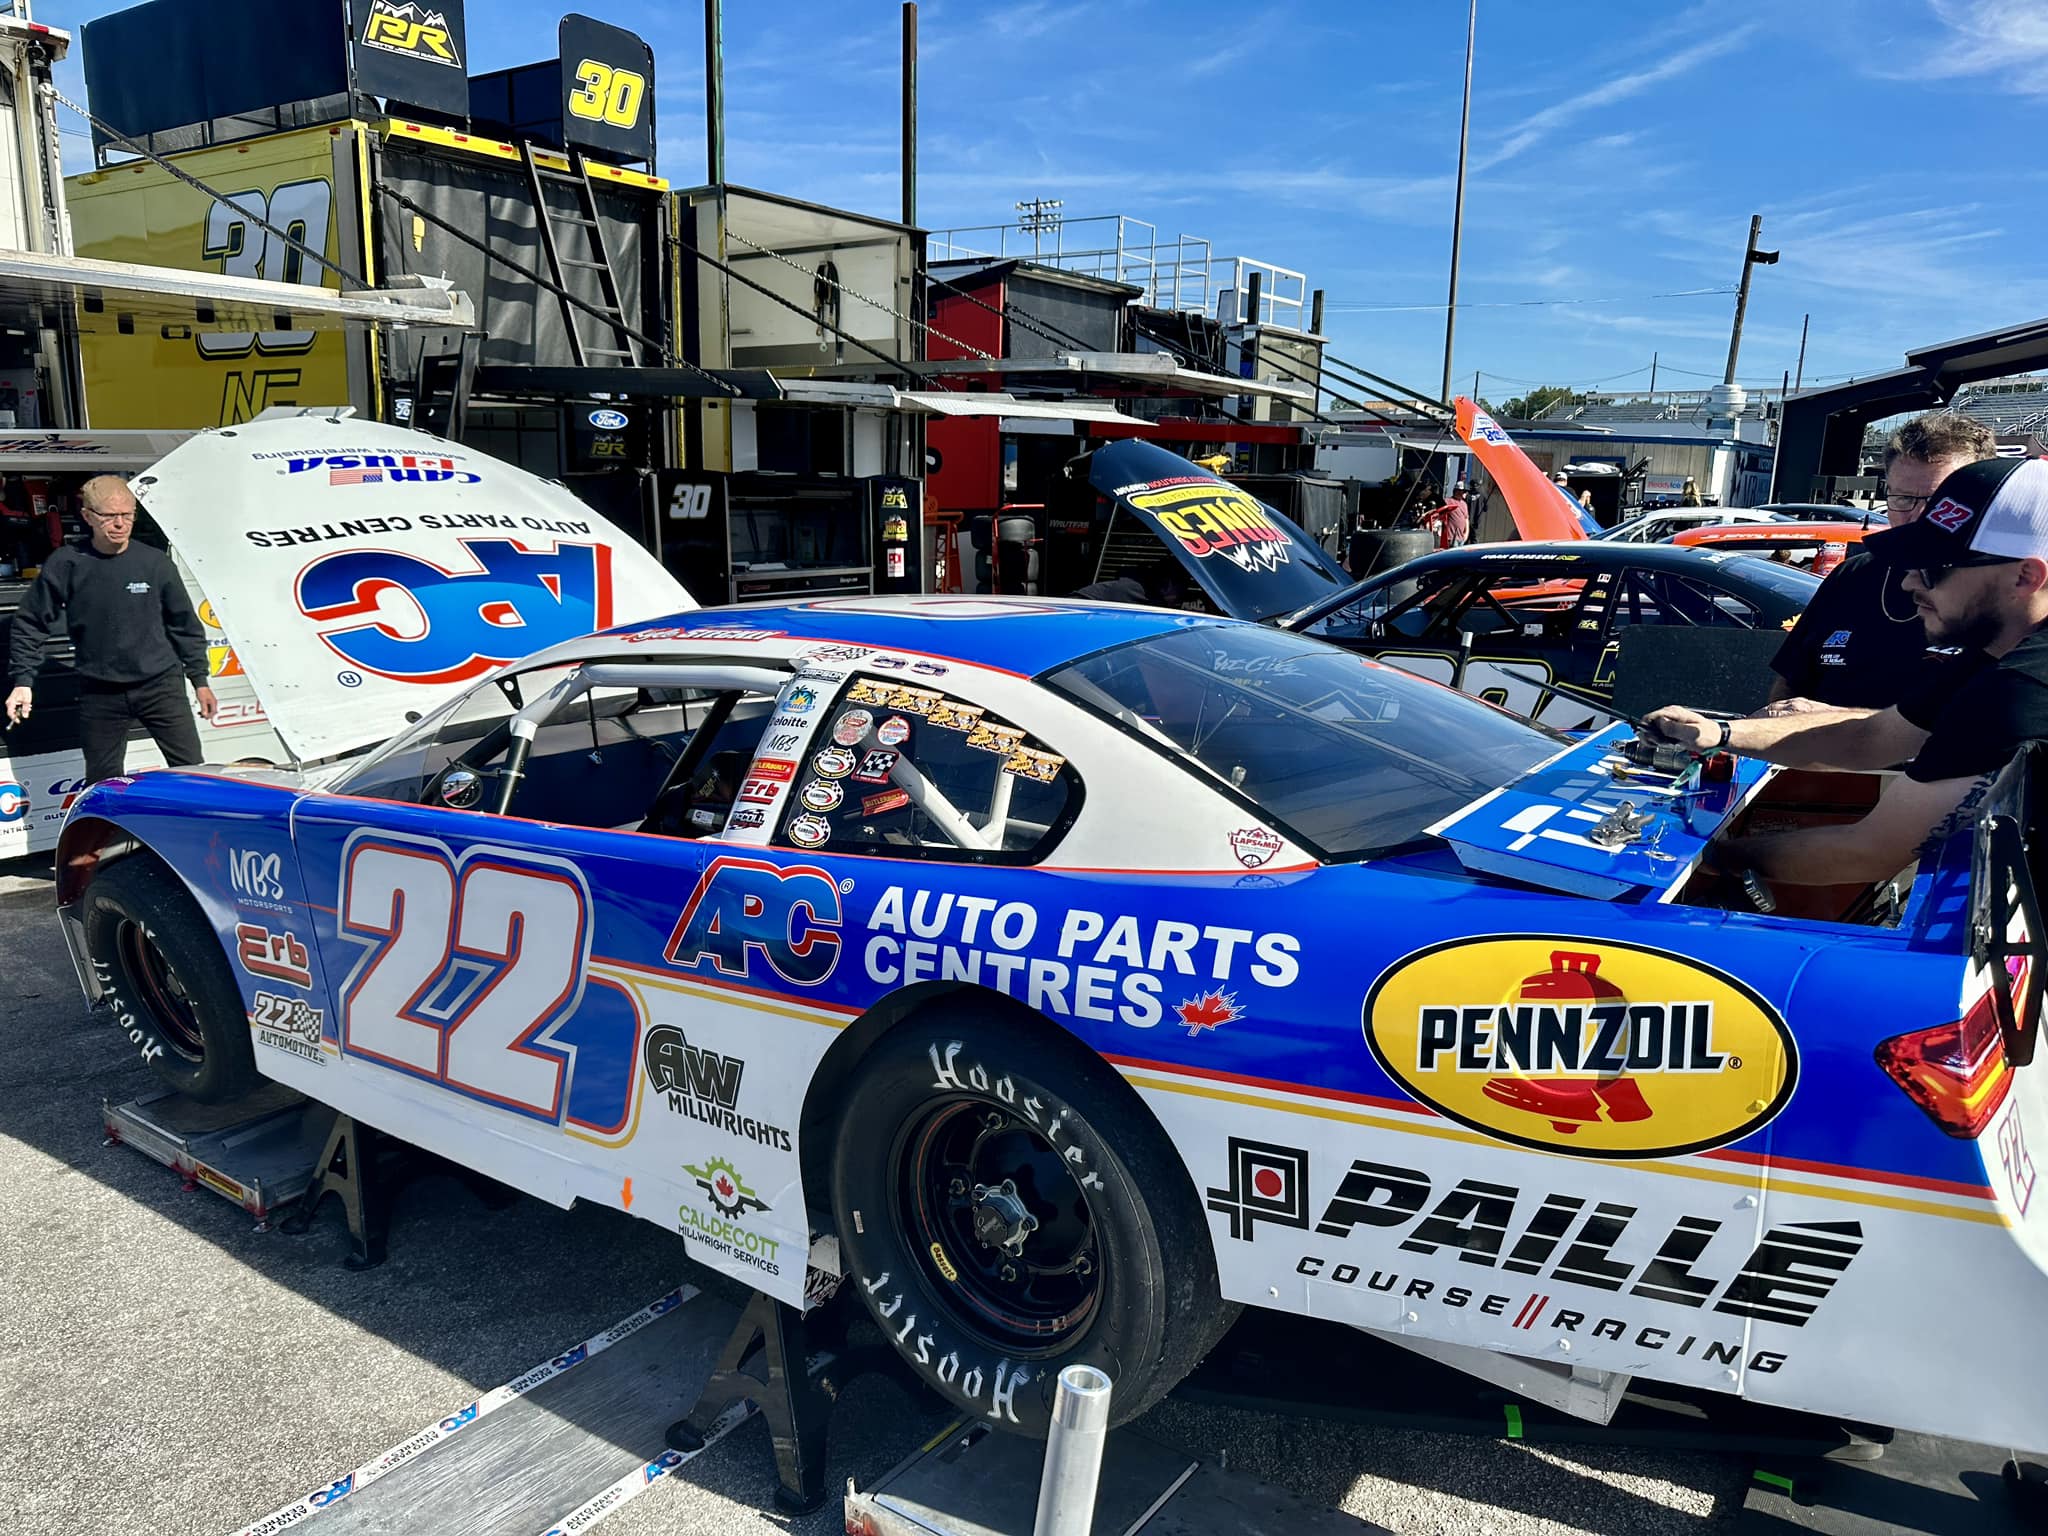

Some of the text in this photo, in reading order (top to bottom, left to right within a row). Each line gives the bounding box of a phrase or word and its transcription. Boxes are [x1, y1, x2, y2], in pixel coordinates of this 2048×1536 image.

[366, 12, 455, 60] RJR
[568, 58, 645, 129] 30
[251, 446, 371, 462] warehousing
[244, 514, 592, 548] AUTO PARTS CENTRES
[669, 484, 712, 519] 30
[1157, 492, 1289, 555] JONES
[1927, 498, 1974, 532] 22
[294, 537, 613, 685] APC
[229, 847, 284, 900] MBS
[238, 897, 293, 914] MOTORSPORTS
[664, 855, 845, 988] APC
[236, 923, 311, 989] Erb
[866, 886, 1302, 989] AUTO PARTS
[341, 834, 591, 1128] 22
[863, 935, 1164, 1030] CENTRES
[254, 990, 295, 1034] 22
[1416, 1000, 1731, 1074] PENNZOIL
[259, 1029, 320, 1063] AUTOMOTIVE
[643, 1023, 745, 1111] AW
[668, 1091, 793, 1153] MILLWRIGHTS
[929, 1041, 1105, 1192] Hoosier
[678, 1204, 780, 1261] CALDECOTT
[678, 1223, 780, 1277] MILLWRIGHT SERVICES
[1295, 1255, 1788, 1377] COURSE RACING
[863, 1272, 1031, 1424] Hoosier
[252, 1504, 305, 1534] CENTRES
[277, 1507, 308, 1528] AUTO
[308, 1471, 356, 1508] APC
